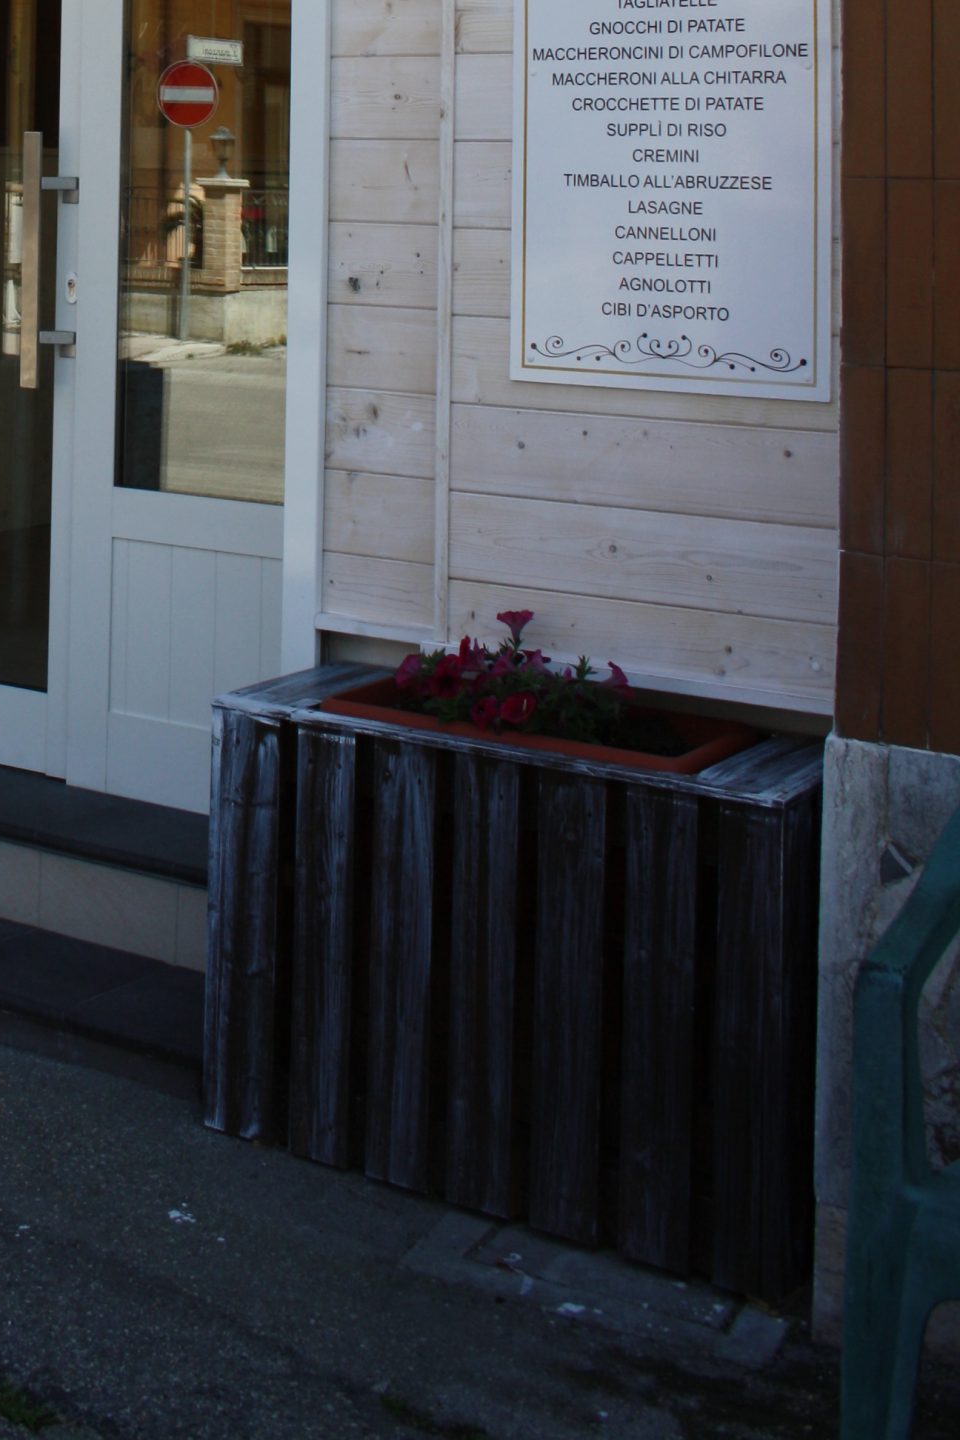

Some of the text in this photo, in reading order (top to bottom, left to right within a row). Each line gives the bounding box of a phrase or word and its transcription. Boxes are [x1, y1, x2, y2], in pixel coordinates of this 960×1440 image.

[589, 18, 745, 35] GNOCCHI DI PATATE
[532, 43, 809, 61] MACCHERONCINI DI CAMPOFILONE
[552, 70, 787, 86] MACCHERONI ALLA CHITARRA
[572, 96, 764, 111] CROCCHETTE DI PATATE
[666, 123, 683, 137] DI
[687, 123, 727, 138] RISO
[632, 149, 699, 163] CREMINI
[563, 173, 772, 190] TIMBALLO ALL'ABRUZZESE
[628, 200, 703, 215] LASAGNE
[614, 226, 717, 242] CANNELLONI
[612, 251, 718, 268] CAPPELLETTI
[619, 277, 711, 294] AGNOLOTTI
[601, 302, 730, 321] CIBI D'ASPORTO
